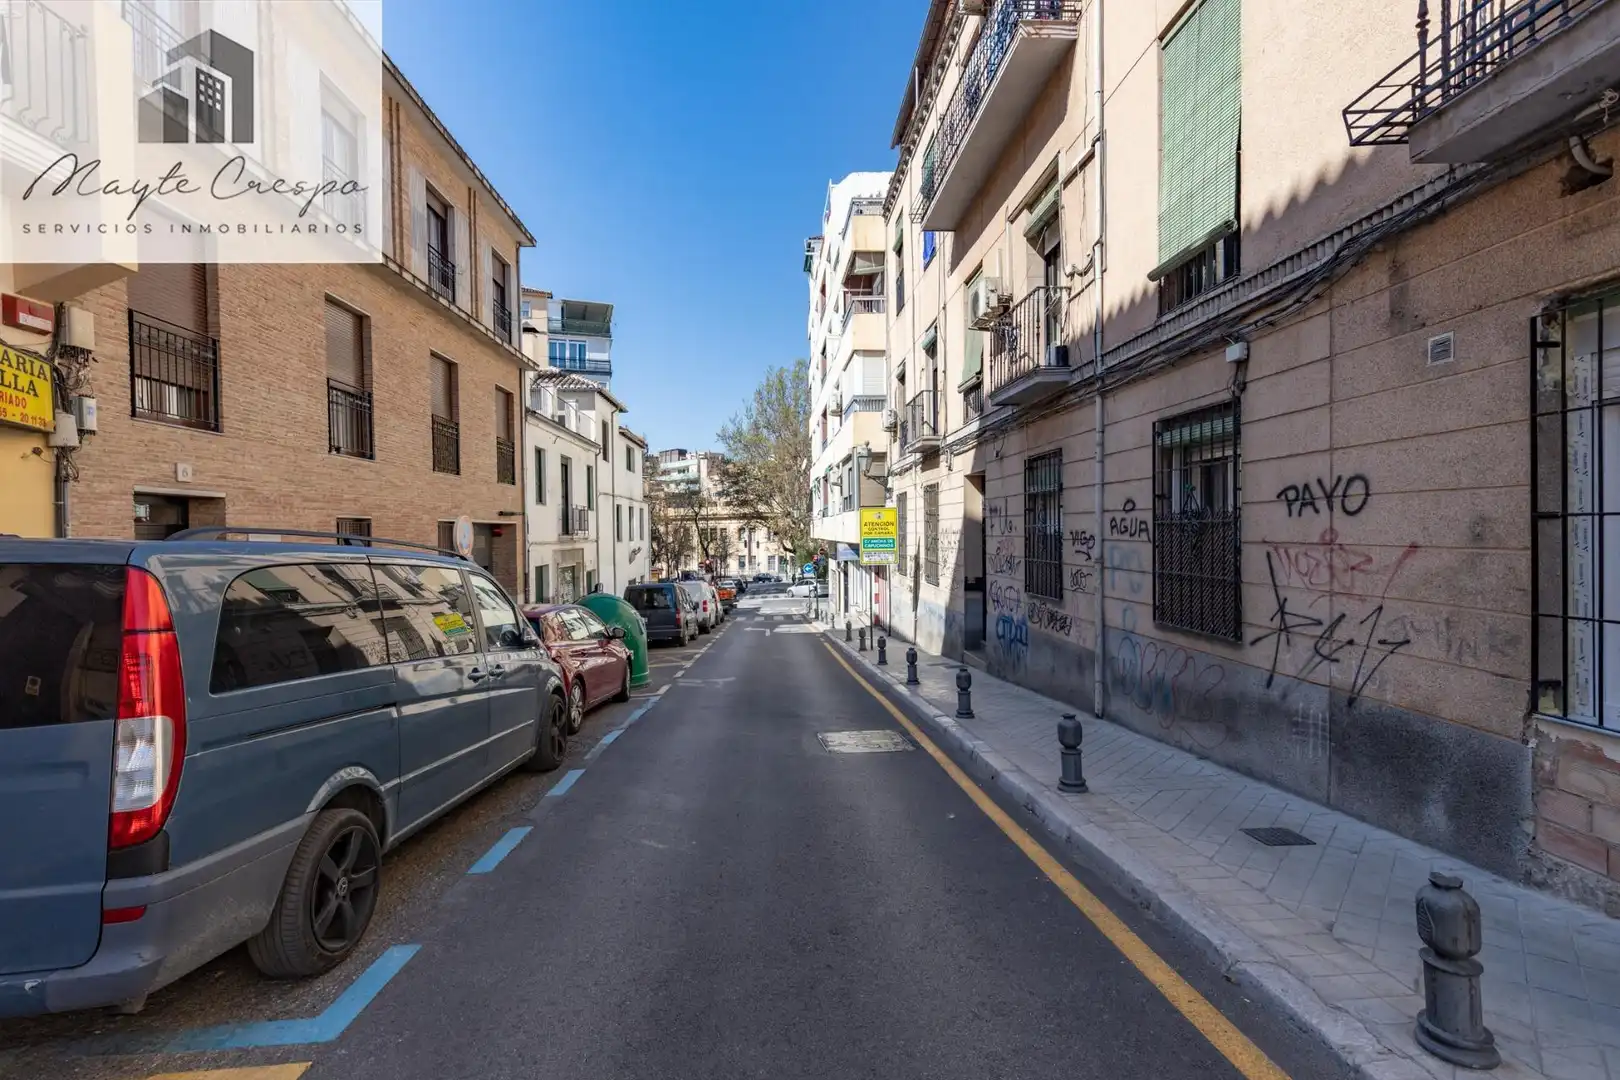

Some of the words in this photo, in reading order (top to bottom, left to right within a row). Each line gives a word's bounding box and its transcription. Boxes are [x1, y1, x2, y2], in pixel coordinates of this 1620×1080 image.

[0, 349, 48, 382] ARIA
[181, 467, 189, 478] 6
[1276, 474, 1370, 517] PAYO
[1110, 516, 1152, 543] AGUA
